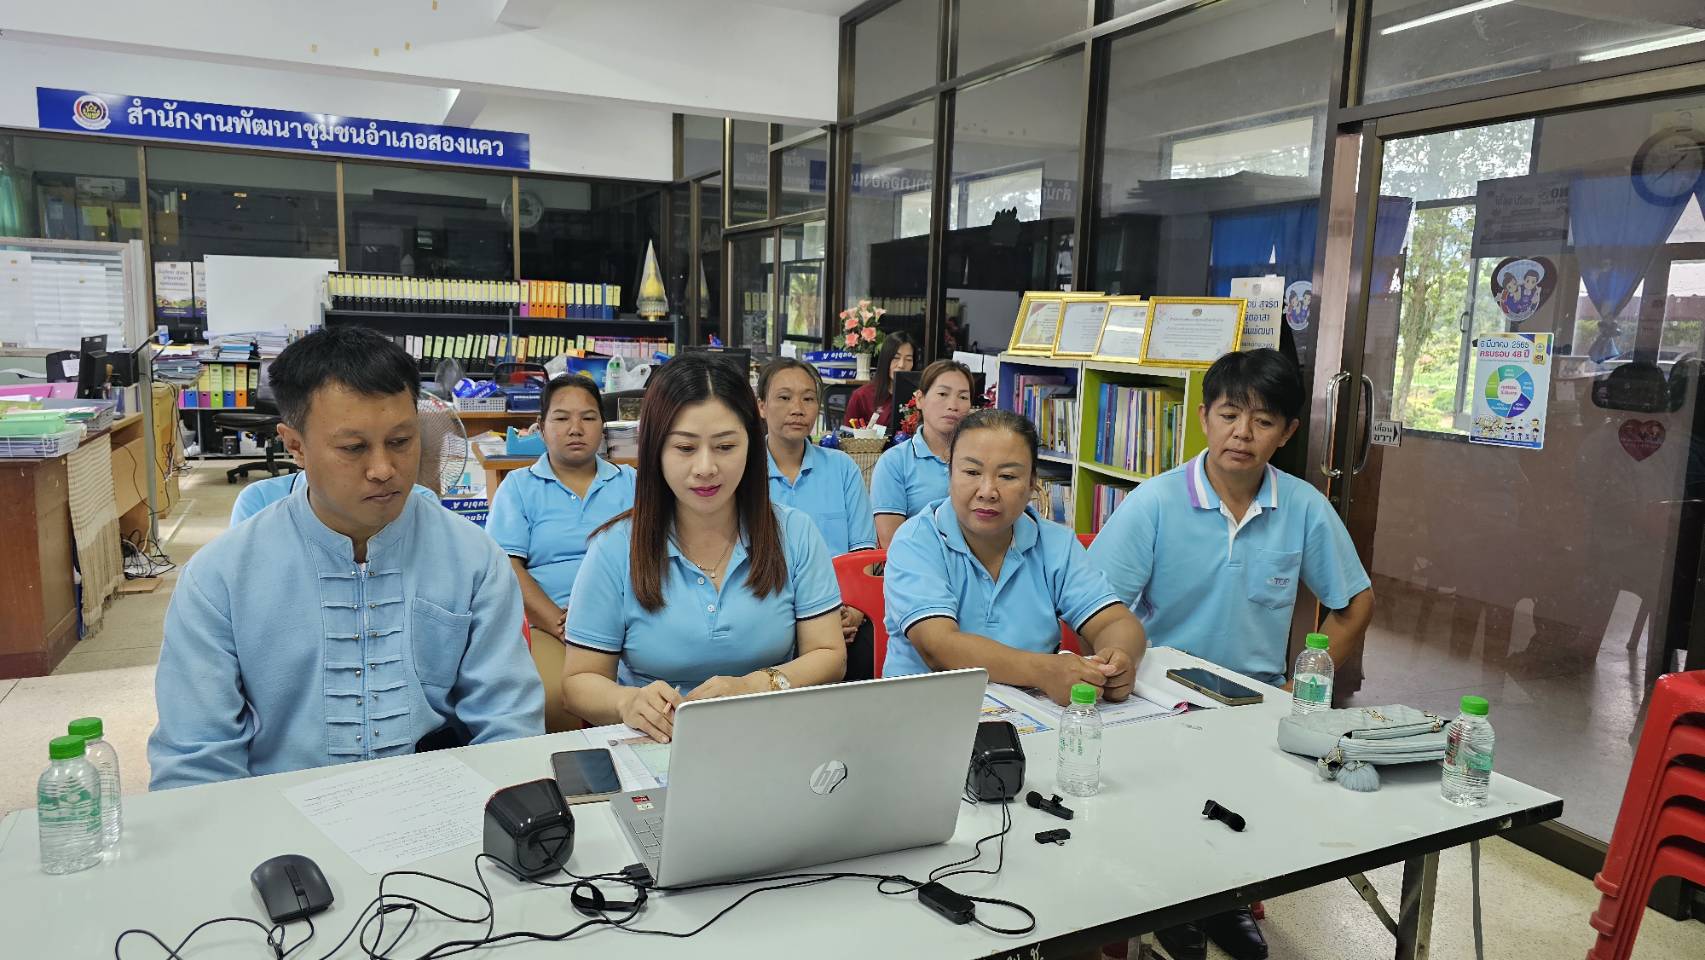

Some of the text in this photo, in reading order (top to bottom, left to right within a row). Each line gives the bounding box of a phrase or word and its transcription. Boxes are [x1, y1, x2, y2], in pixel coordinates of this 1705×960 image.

[126, 97, 505, 157] สำนักงานพัฒนาชุมชนอำเภอสองแคว
[1480, 350, 1510, 358] ครบรอบ
